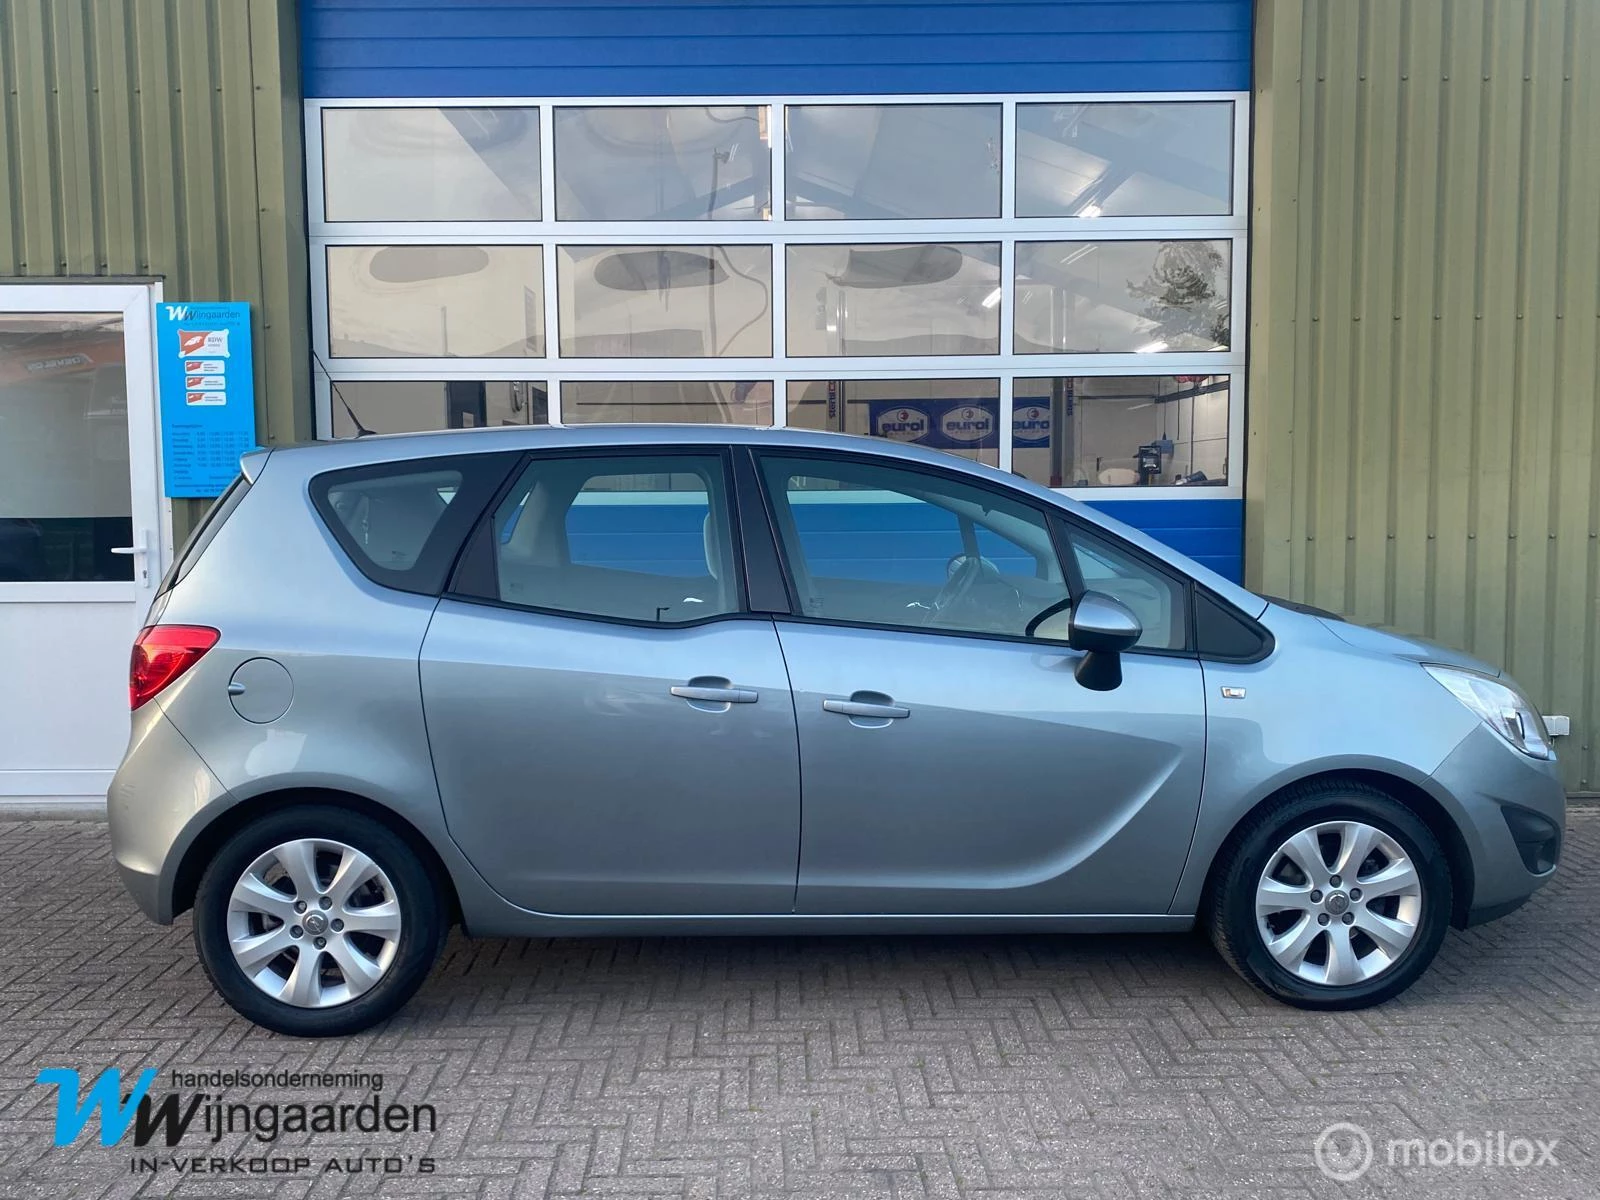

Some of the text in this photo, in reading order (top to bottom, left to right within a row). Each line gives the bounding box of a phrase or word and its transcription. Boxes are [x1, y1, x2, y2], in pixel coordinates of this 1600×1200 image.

[882, 419, 925, 432] eurol
[946, 418, 989, 431] eurol
[1012, 420, 1050, 430] euro
